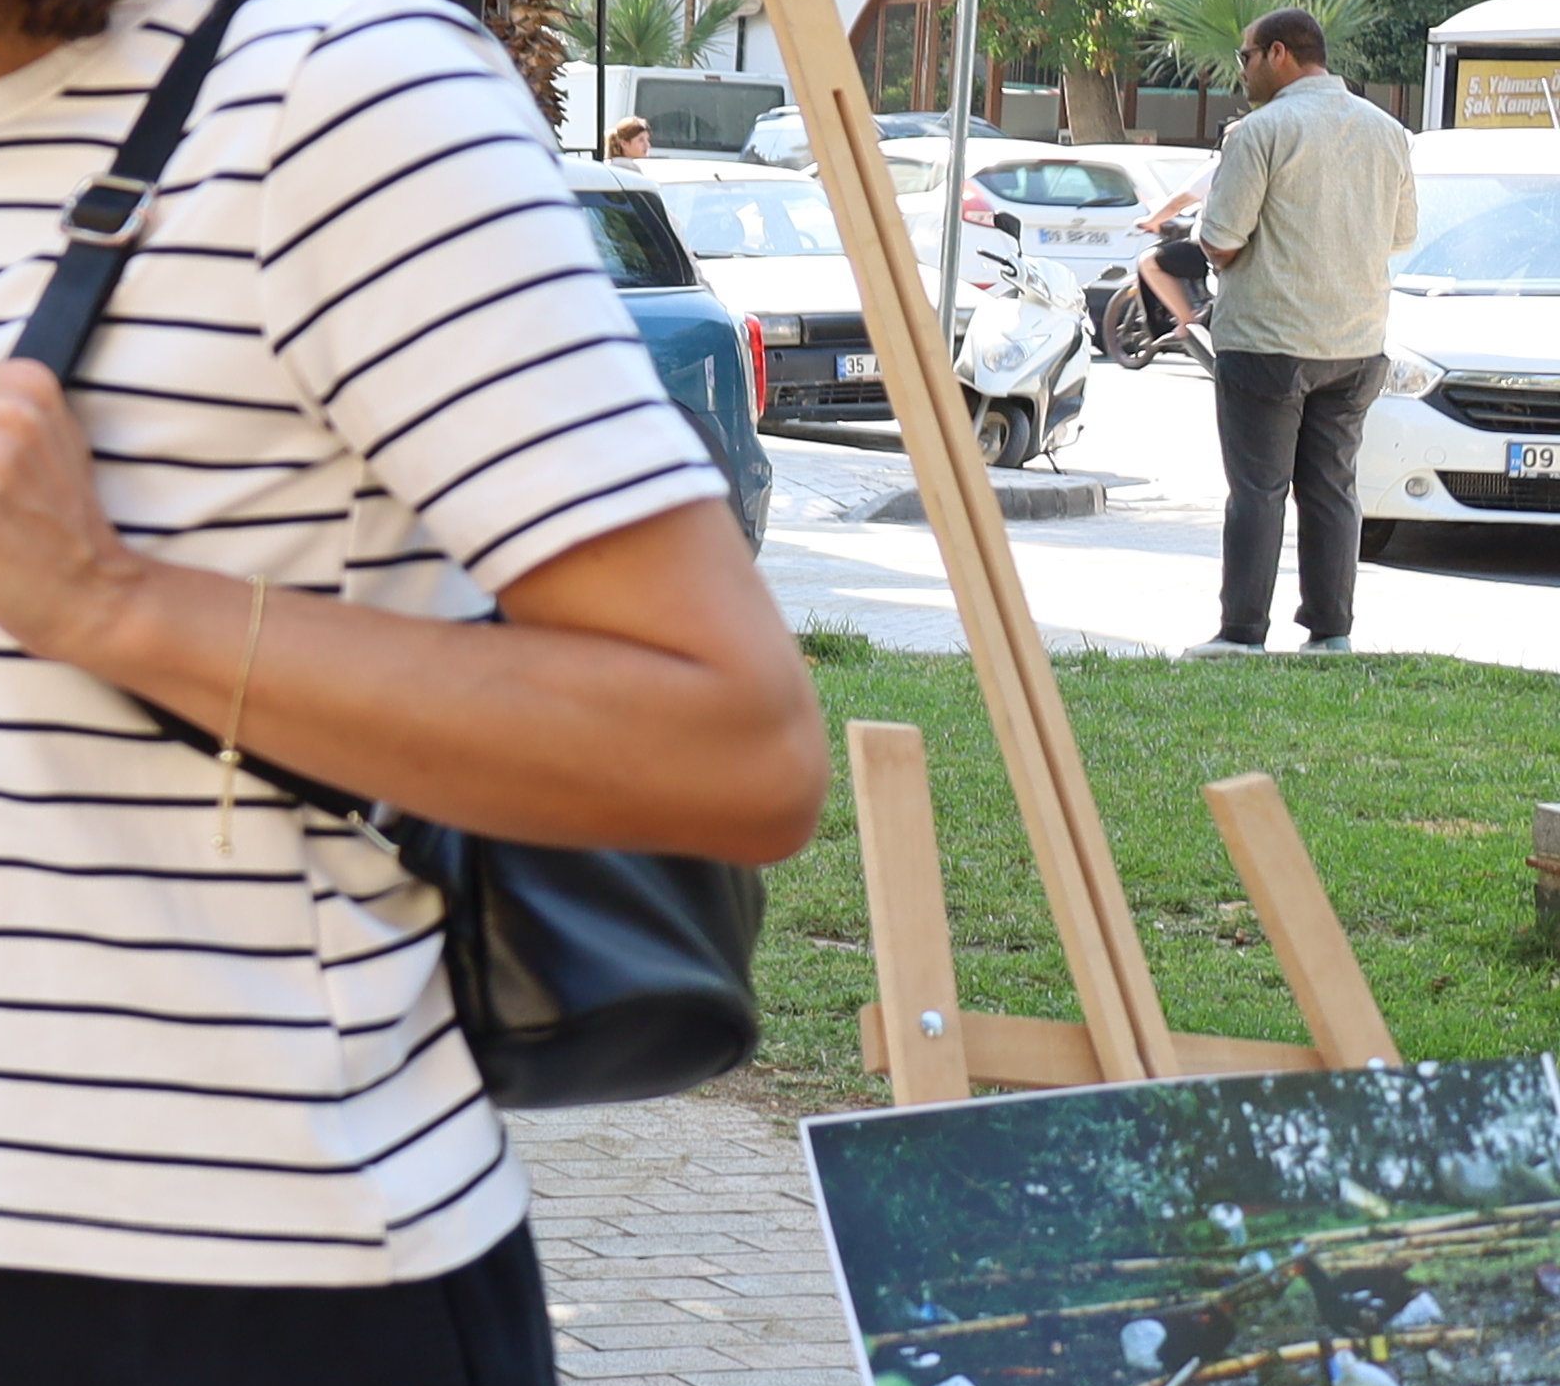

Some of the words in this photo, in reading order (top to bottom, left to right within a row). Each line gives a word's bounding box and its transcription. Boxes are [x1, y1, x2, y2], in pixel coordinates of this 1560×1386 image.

[1468, 76, 1482, 95] 5.
[847, 356, 865, 374] 35
[1523, 447, 1554, 469] 09
